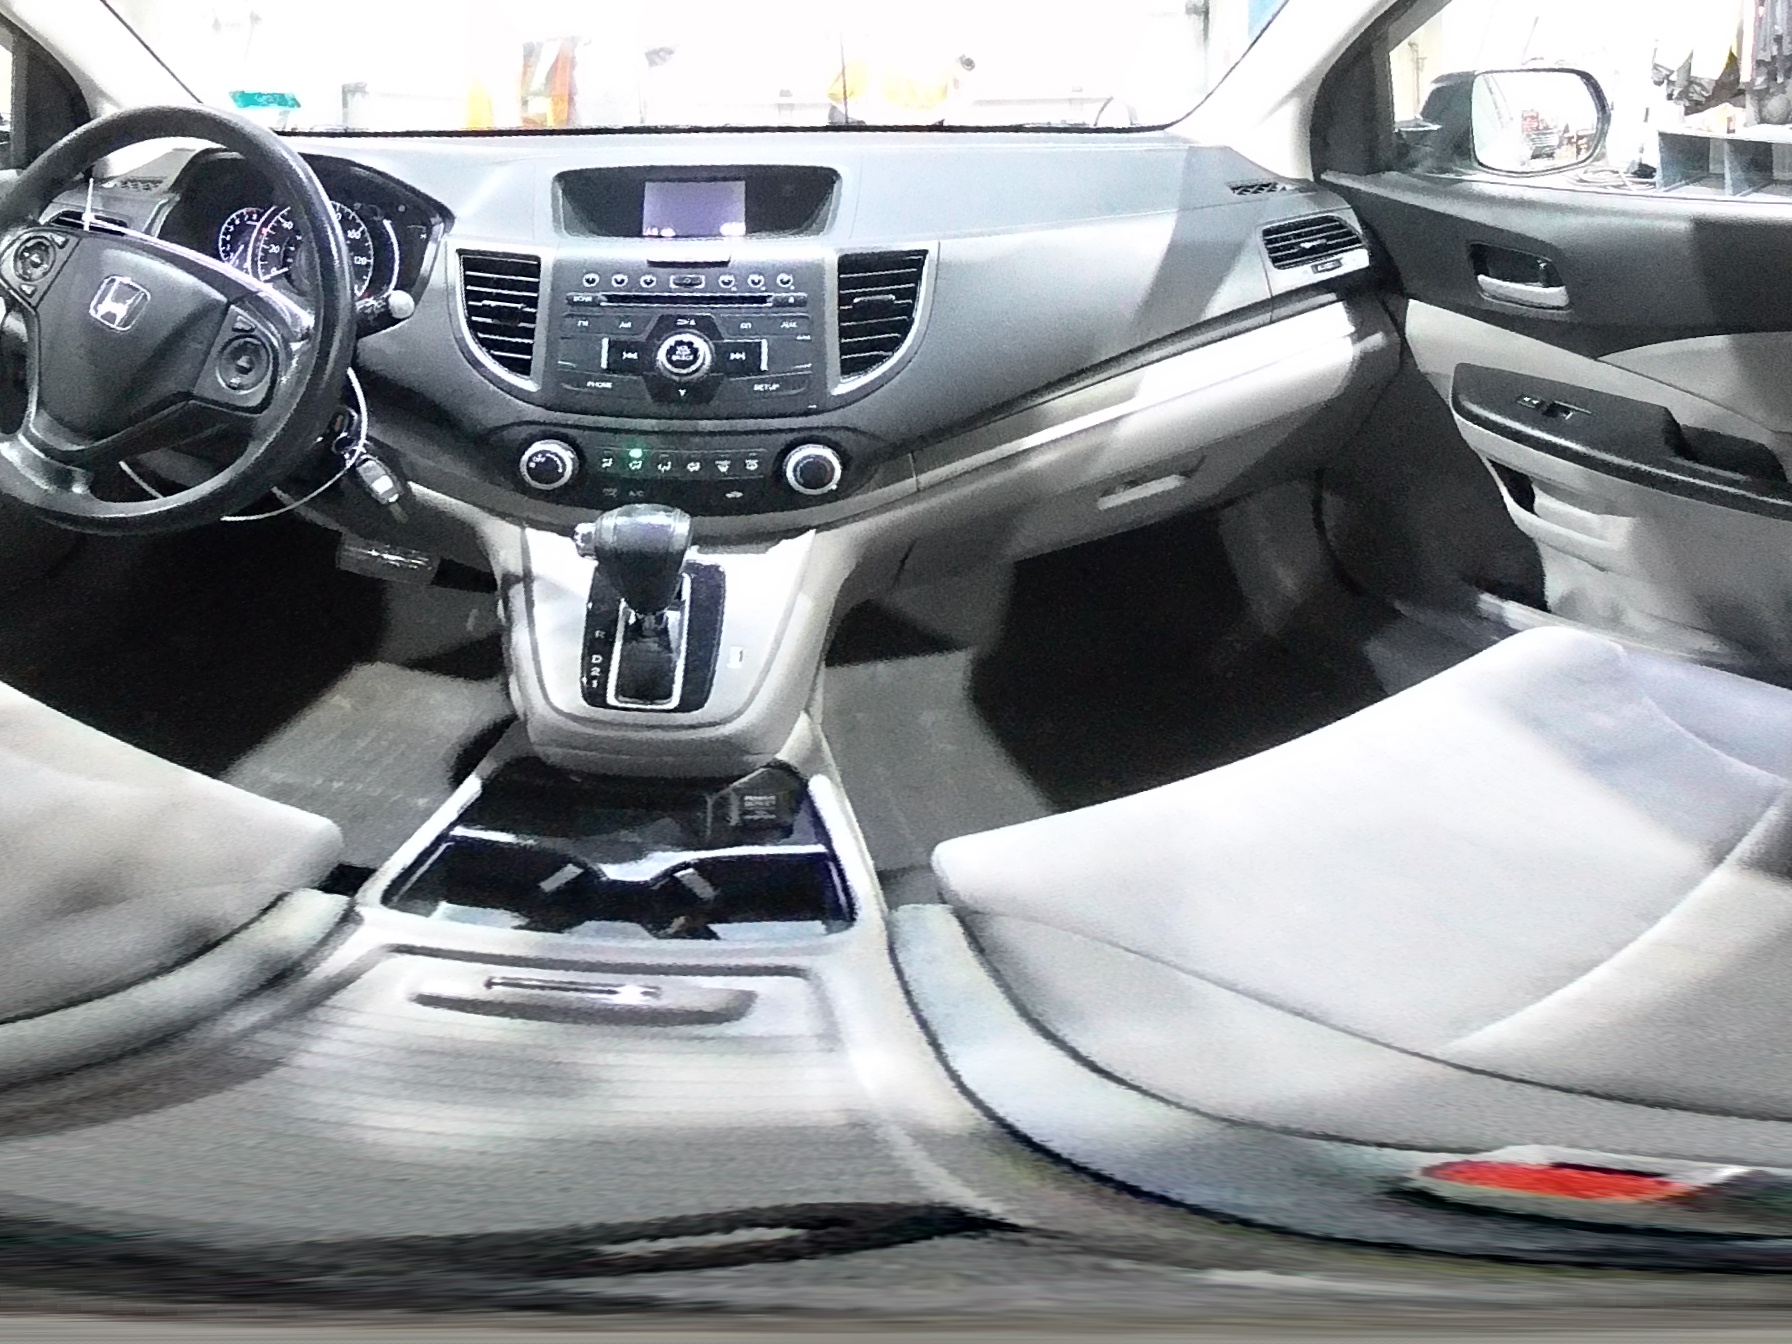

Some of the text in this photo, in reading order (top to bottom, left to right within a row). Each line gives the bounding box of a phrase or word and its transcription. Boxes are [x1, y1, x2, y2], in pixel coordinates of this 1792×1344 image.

[594, 629, 606, 639] R
[591, 654, 604, 664] D
[590, 666, 601, 677] 2
